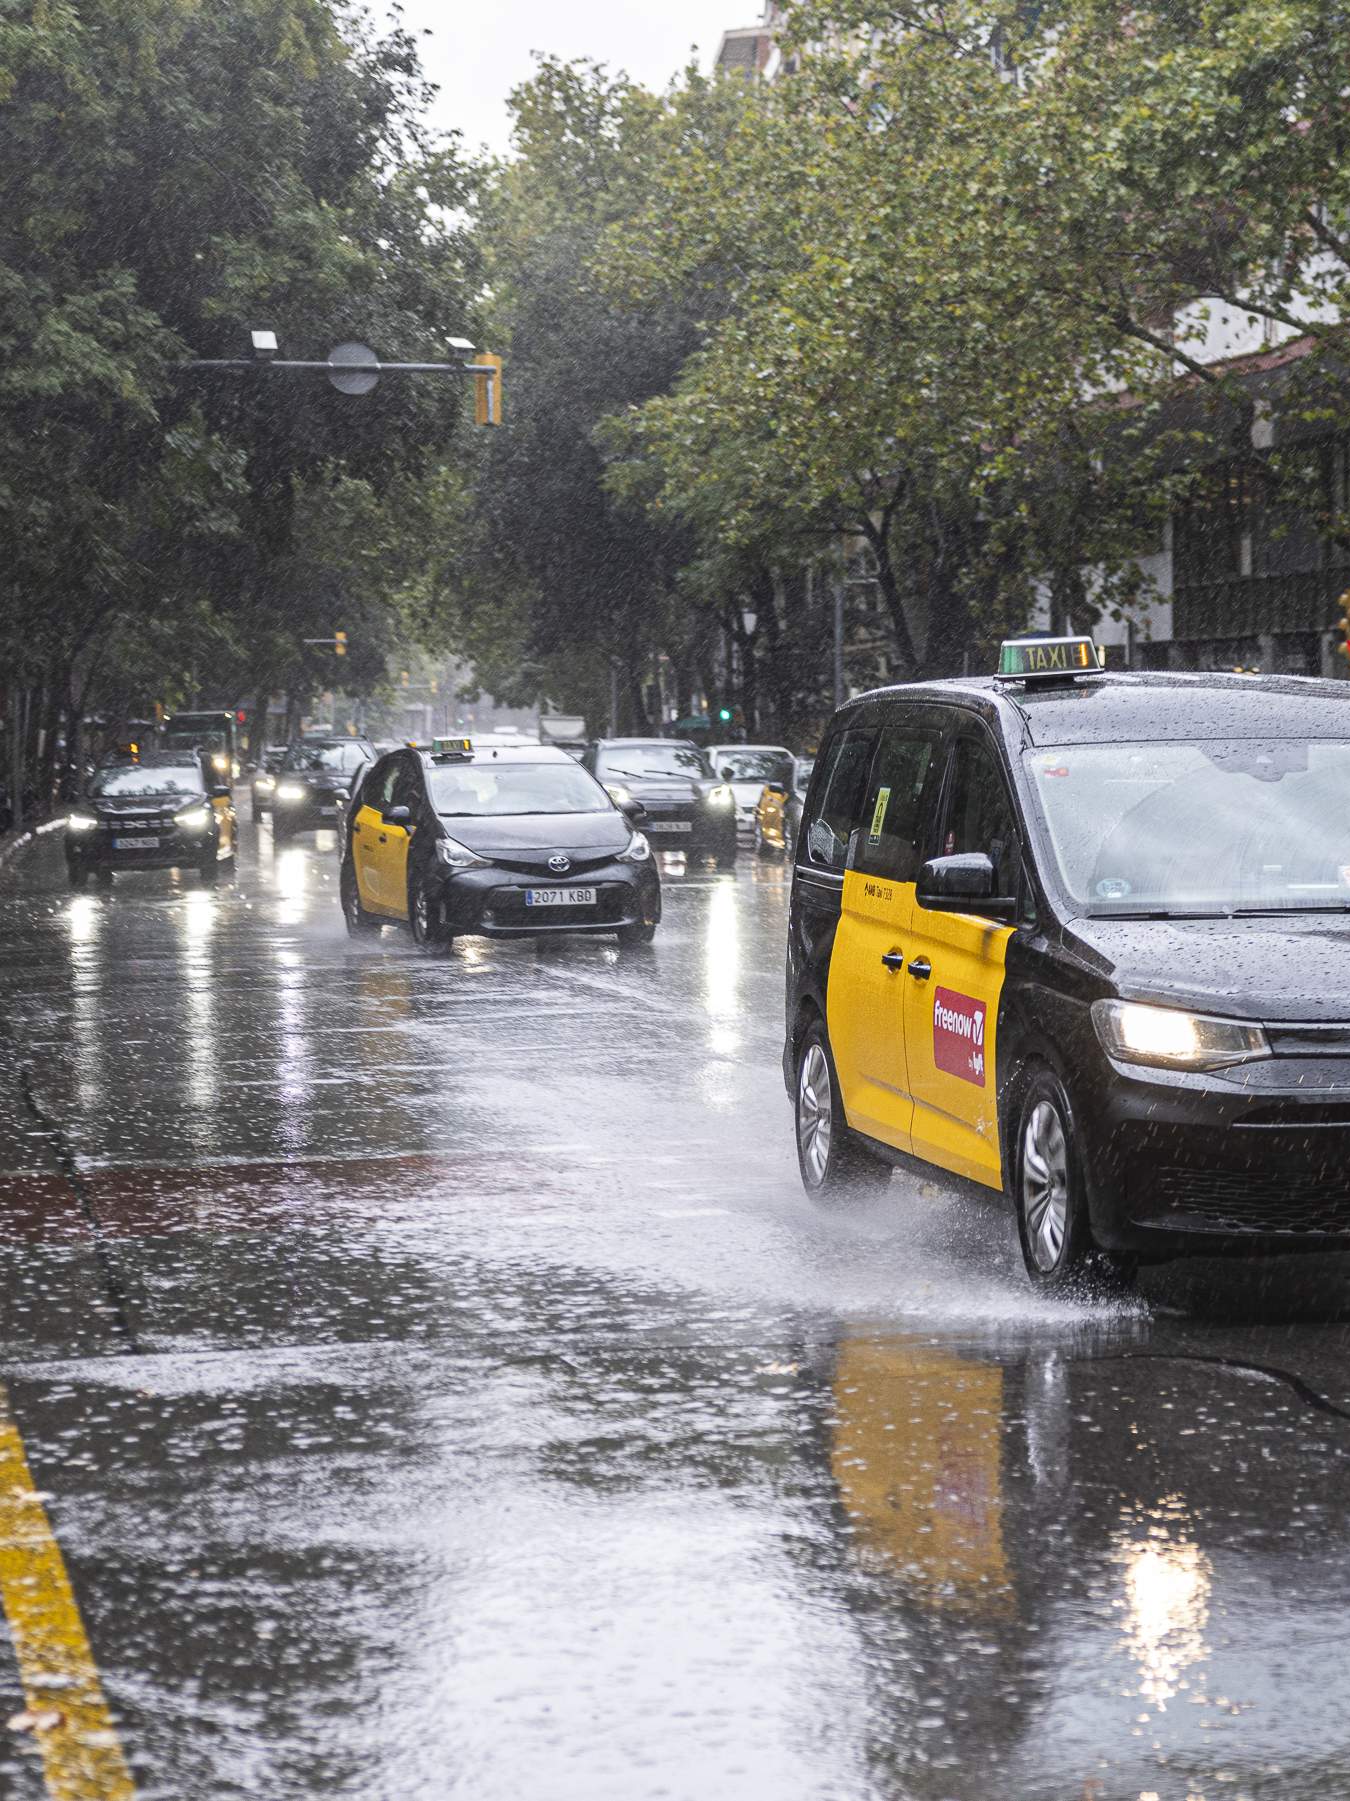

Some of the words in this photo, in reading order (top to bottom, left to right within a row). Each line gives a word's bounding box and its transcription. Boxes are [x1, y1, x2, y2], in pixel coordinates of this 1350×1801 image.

[1026, 645, 1067, 670] TAXI
[534, 891, 564, 903] 2071
[935, 1000, 972, 1038] freenow
